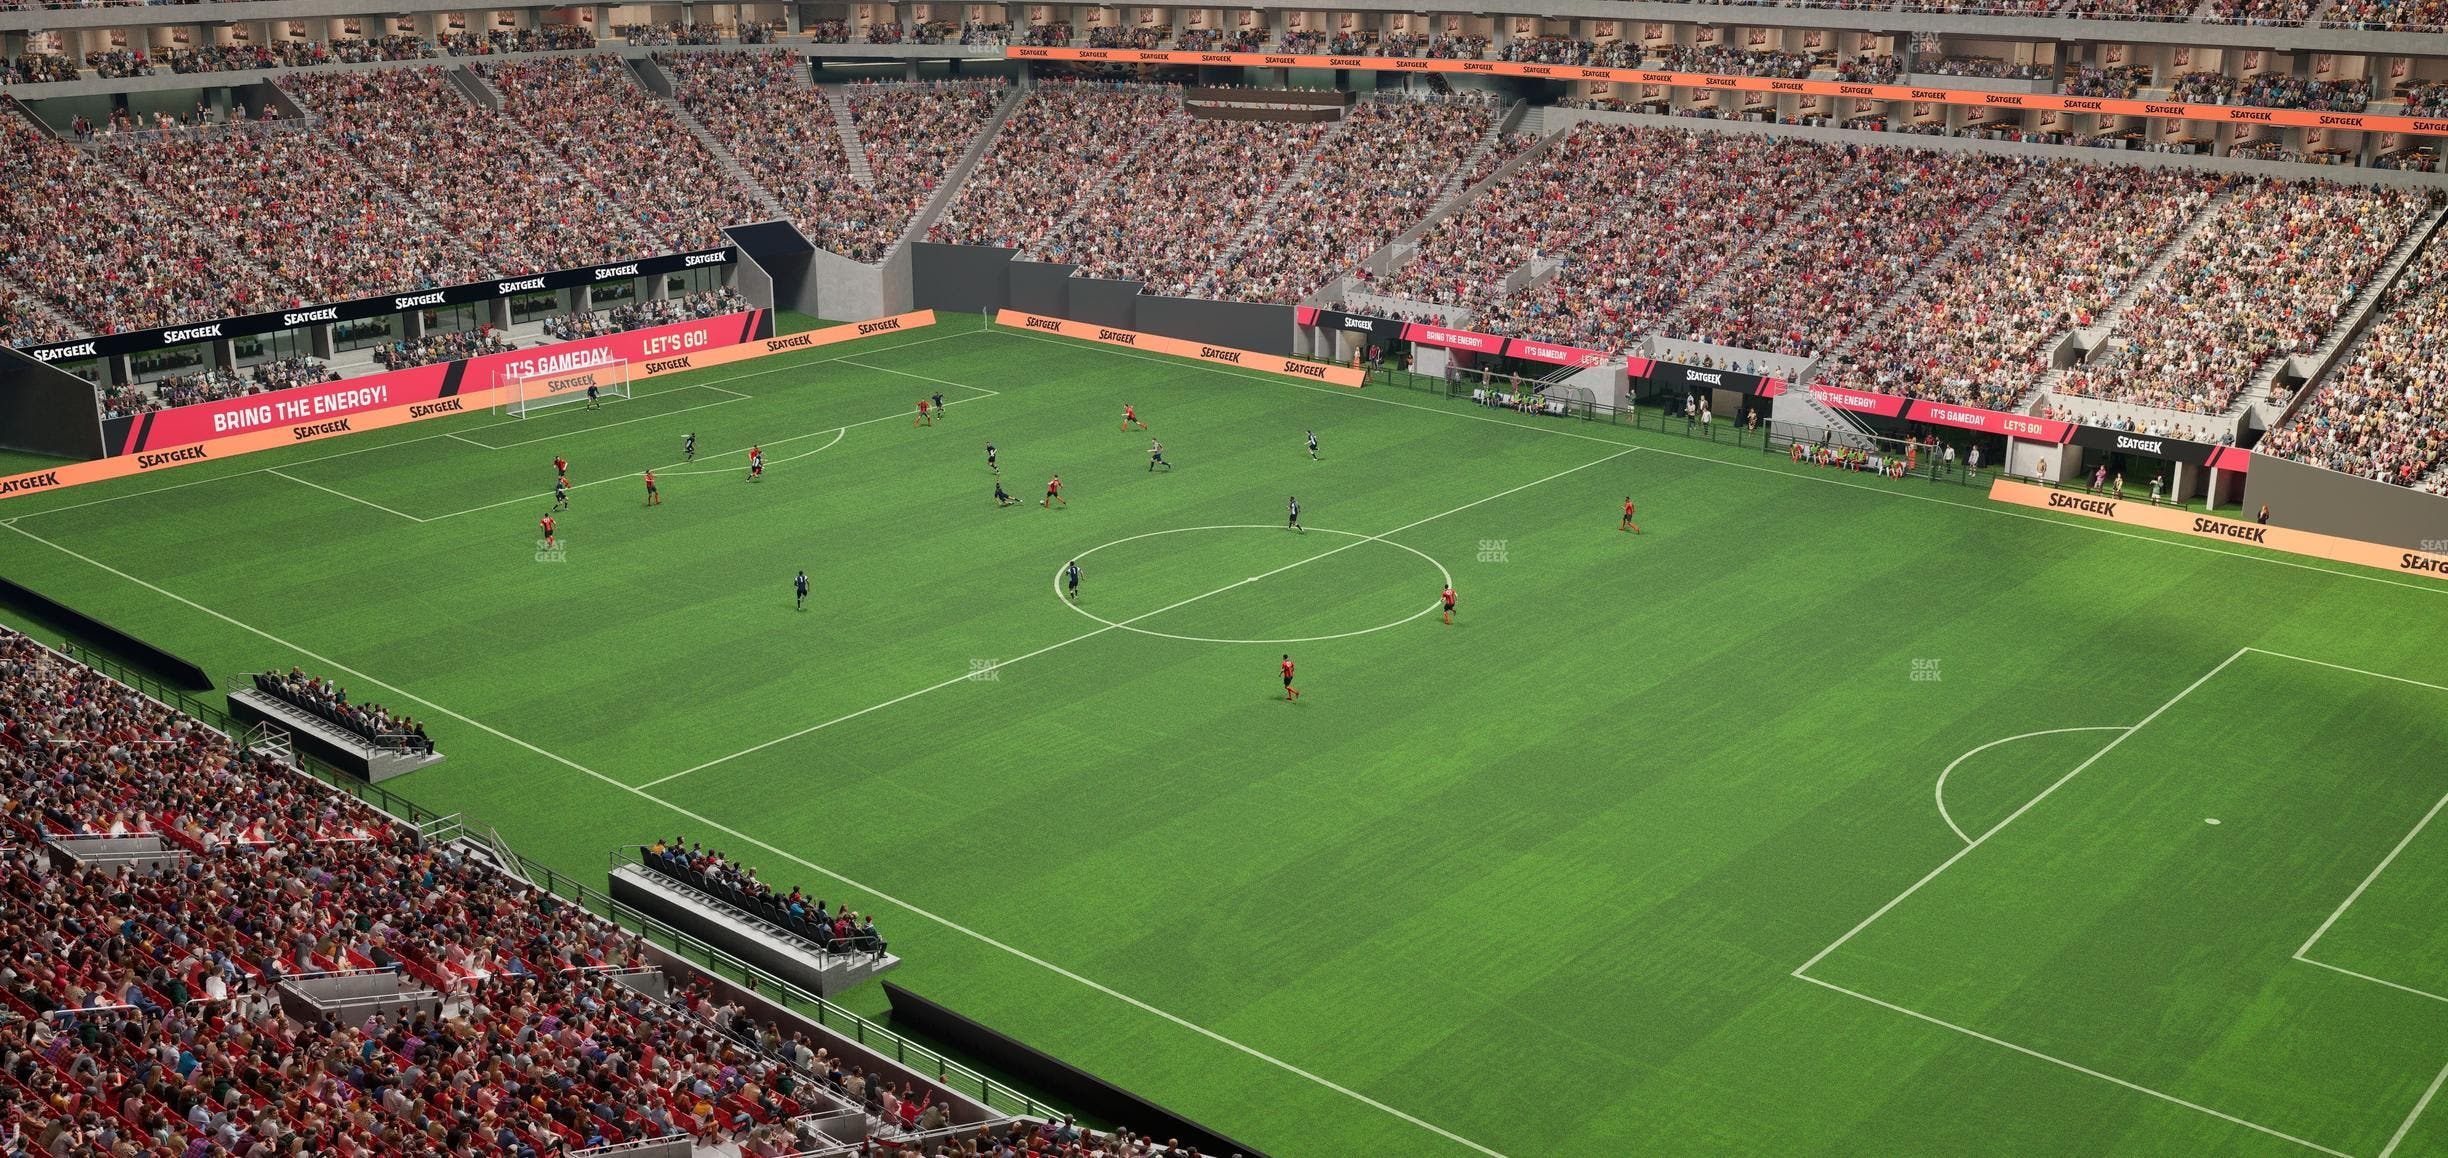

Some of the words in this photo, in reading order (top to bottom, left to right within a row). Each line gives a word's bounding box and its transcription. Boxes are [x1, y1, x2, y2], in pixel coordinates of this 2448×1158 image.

[1524, 66, 1550, 74] SEATGEEK
[1582, 70, 1610, 78] SEATGEEK
[1643, 74, 1671, 82] SEATGEEK
[1706, 78, 1736, 86] SEATGEEK
[1772, 82, 1803, 90] SEATGEEK
[1841, 86, 1873, 94] SEATGEEK
[1911, 90, 1946, 100] SEATGEEK
[1986, 95, 2022, 104] SEATGEEK
[2064, 100, 2101, 109] SEATGEEK
[2145, 105, 2184, 115] SEATGEEK
[2231, 110, 2271, 120] SEATGEEK
[2320, 116, 2362, 126] SEATGEEK
[685, 251, 725, 266] SEATGEEK
[596, 264, 638, 279] SEATGEEK
[499, 276, 545, 294] SEATGEEK
[396, 291, 445, 309] SEATGEEK
[284, 307, 337, 325] SEATGEEK
[1026, 317, 1061, 331] SEATGEEK
[1345, 315, 1372, 331] SEATGEEK
[164, 324, 222, 343] SEATGEEK
[858, 318, 900, 334] SEATGEEK
[644, 335, 681, 355] LET'S
[684, 330, 707, 347] GO!
[767, 335, 812, 351] SEATGEEK
[1099, 329, 1136, 344] SEATGEEK
[1427, 331, 1445, 341] BRING
[1446, 334, 1457, 343] THE
[1458, 336, 1483, 347] ENERGY!
[33, 342, 97, 361] SEATGEEK
[1201, 347, 1240, 363] SEATGEEK
[1525, 346, 1537, 356] IT'S
[1538, 348, 1567, 360] GAMEDAY
[505, 360, 534, 380] IT'S
[538, 346, 608, 375] GAMEDAY
[646, 357, 691, 374] SEATGEEK
[1284, 361, 1326, 378] SEATGEEK
[548, 374, 594, 392] SEATGEEK
[1687, 370, 1721, 385] SEATGEEK
[214, 406, 271, 431] BRING
[276, 399, 310, 420] THE
[314, 385, 387, 413] ENERGY!
[410, 398, 463, 418] SEATGEEK
[1829, 392, 1843, 404] THE
[1844, 395, 1876, 408] ENERGY!
[1931, 408, 1945, 420] IT'S
[1947, 411, 1985, 425] GAMEDAY
[294, 419, 350, 439] SEATGEEK
[2004, 420, 2025, 432] LET'S
[2028, 424, 2042, 434] GO!
[2117, 436, 2162, 454] SEATGEEK
[138, 445, 207, 468] SEATGEEK
[2049, 493, 2116, 517] SEATGEEK
[2193, 518, 2266, 543] SEATGEEK
